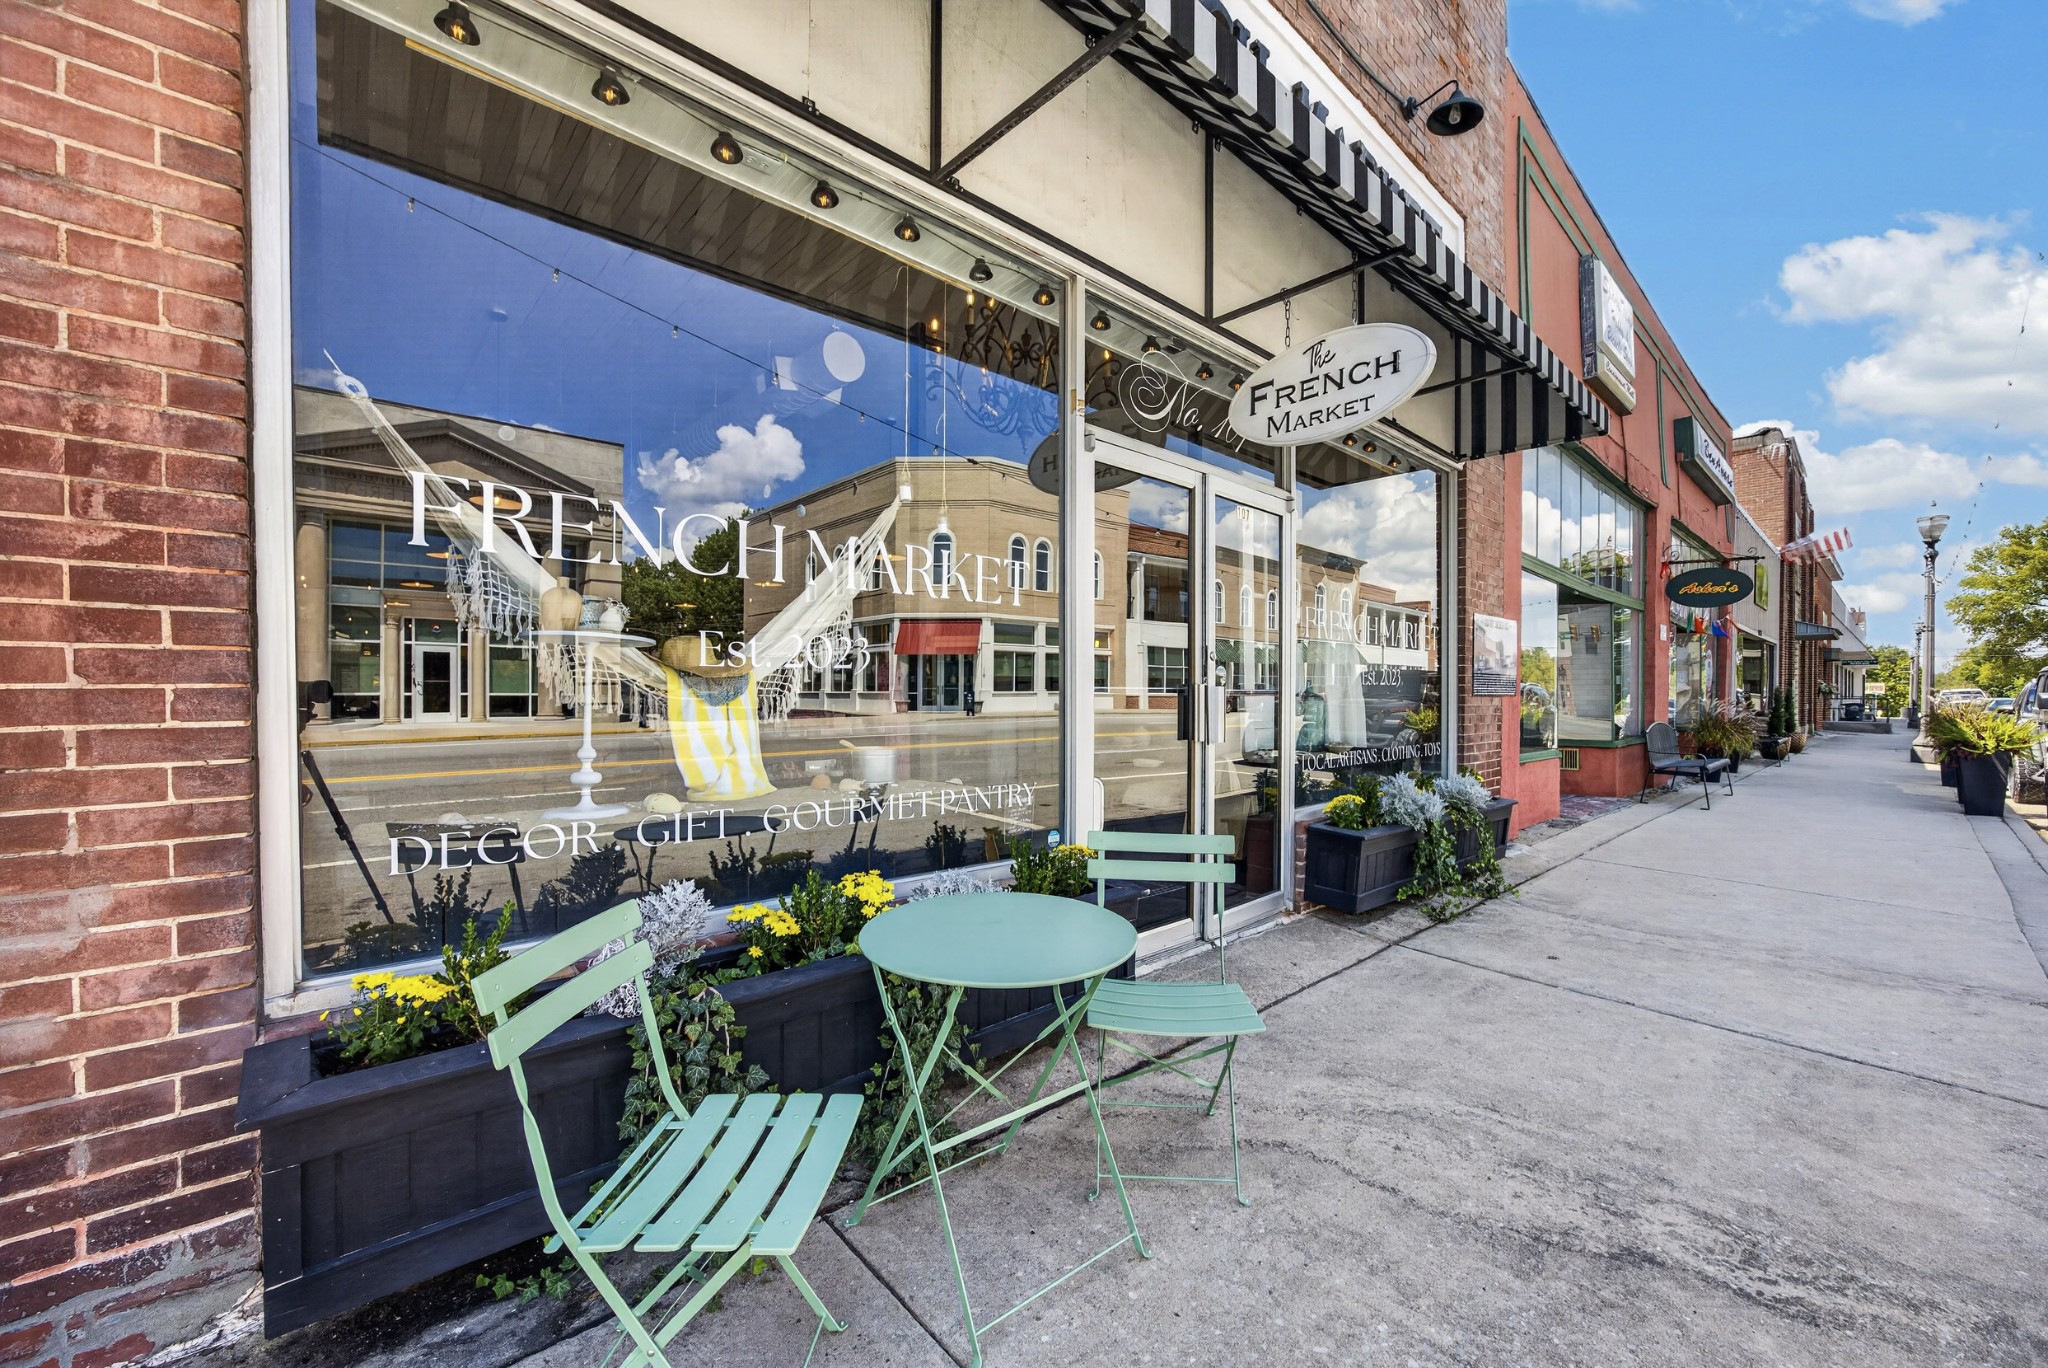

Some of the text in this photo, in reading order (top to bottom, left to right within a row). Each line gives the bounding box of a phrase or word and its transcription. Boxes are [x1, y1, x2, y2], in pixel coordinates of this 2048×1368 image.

[1303, 339, 1336, 374] The
[1118, 351, 1202, 433] No.
[1250, 350, 1401, 416] FRENCH
[1267, 394, 1375, 438] MARKET
[407, 470, 1029, 606] FRENCH MARKET
[1305, 606, 1379, 645] FRENCH
[699, 630, 871, 675] Est. 2023
[1301, 752, 1336, 773] LOCAL
[1424, 741, 1441, 757] TOYS
[388, 821, 601, 876] DECOR
[637, 808, 735, 847] GIFT
[763, 790, 933, 834] GOURMET
[940, 781, 1037, 815] PANTRY
